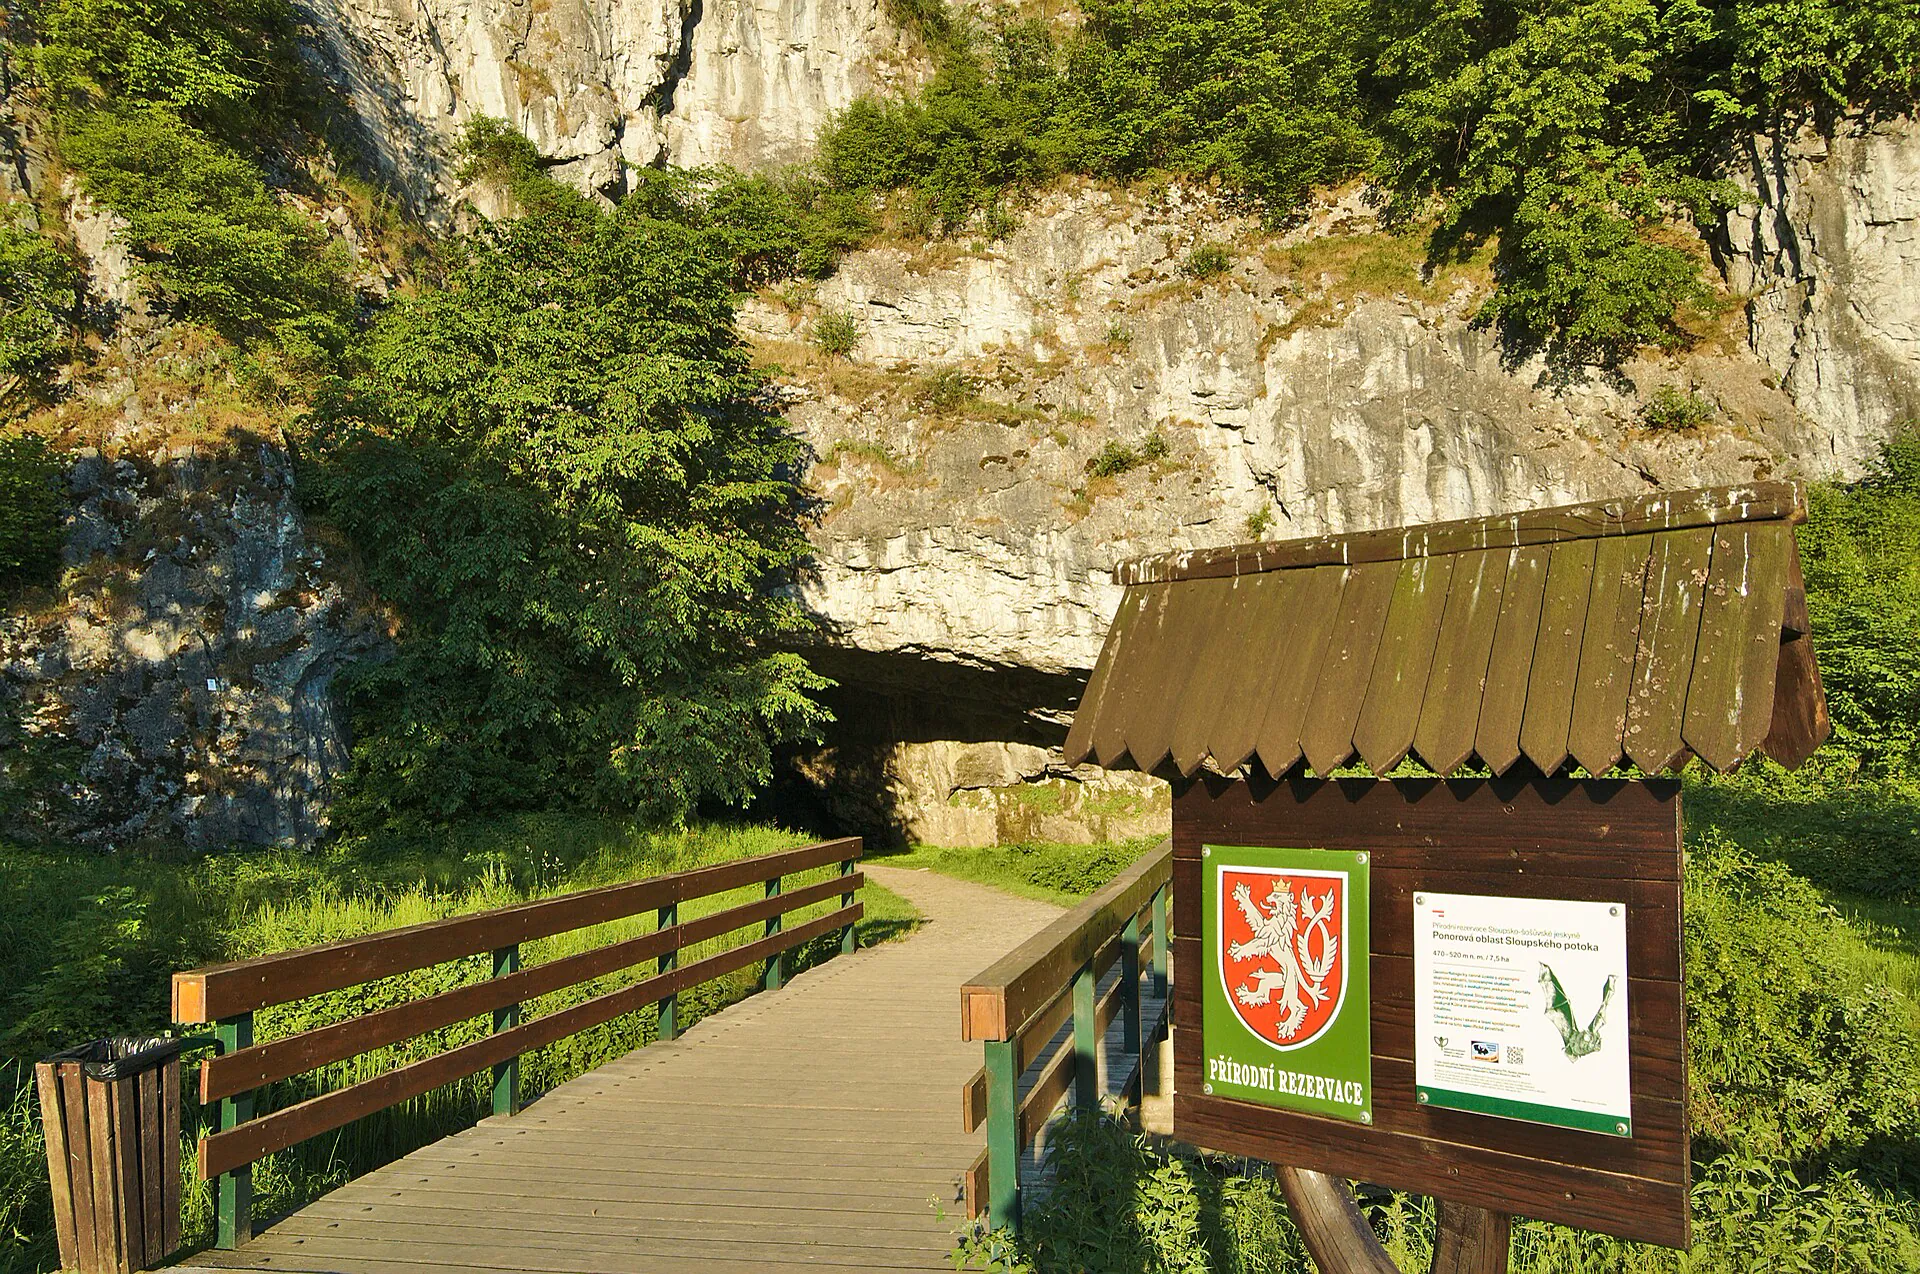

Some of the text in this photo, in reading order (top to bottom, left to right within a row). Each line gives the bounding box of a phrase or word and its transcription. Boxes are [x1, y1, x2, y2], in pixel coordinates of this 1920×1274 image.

[1432, 930, 1599, 952] Ponorová oblast Sloupského potoka
[1500, 955, 1510, 963] ha
[1209, 1054, 1364, 1106] PŘÍRODNÍ REZERVACE
